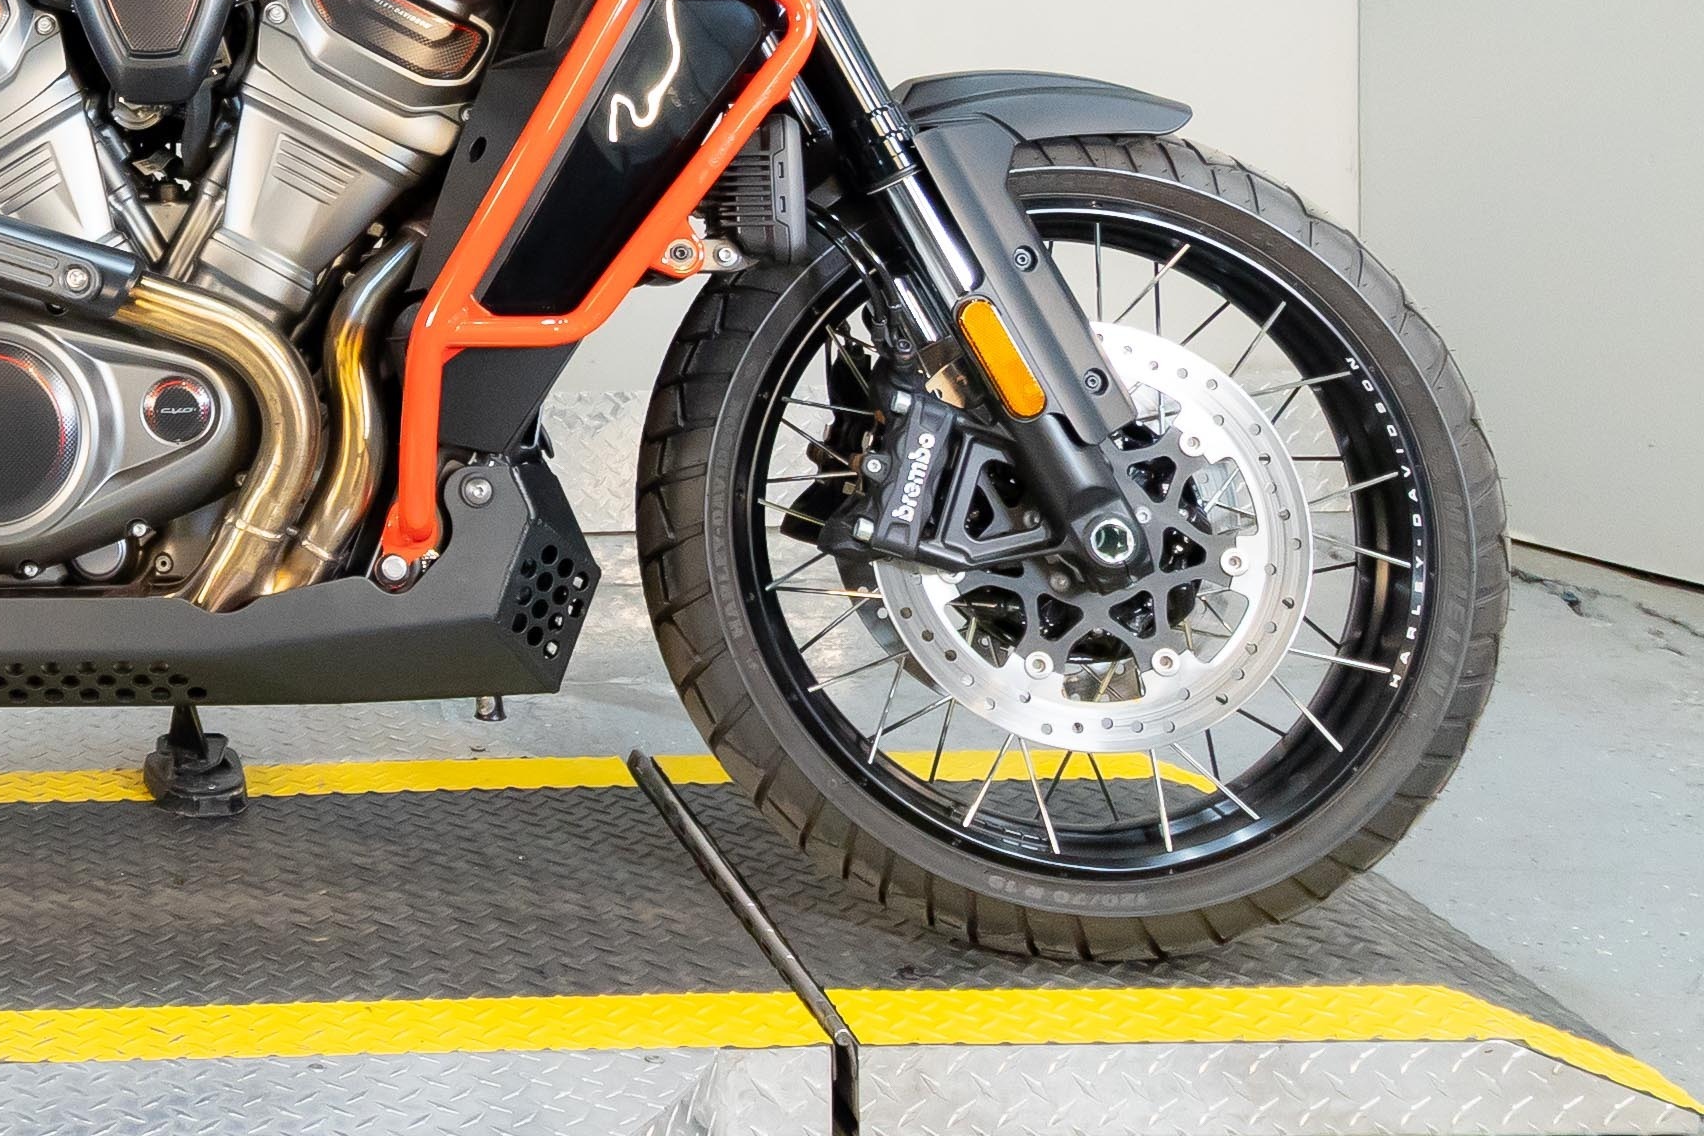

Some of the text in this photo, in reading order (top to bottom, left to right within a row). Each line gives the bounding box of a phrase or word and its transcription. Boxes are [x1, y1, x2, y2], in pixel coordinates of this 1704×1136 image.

[159, 407, 194, 415] CVO
[891, 432, 936, 523] brembo
[1345, 356, 1426, 689] HARLEY-DAVIDSON
